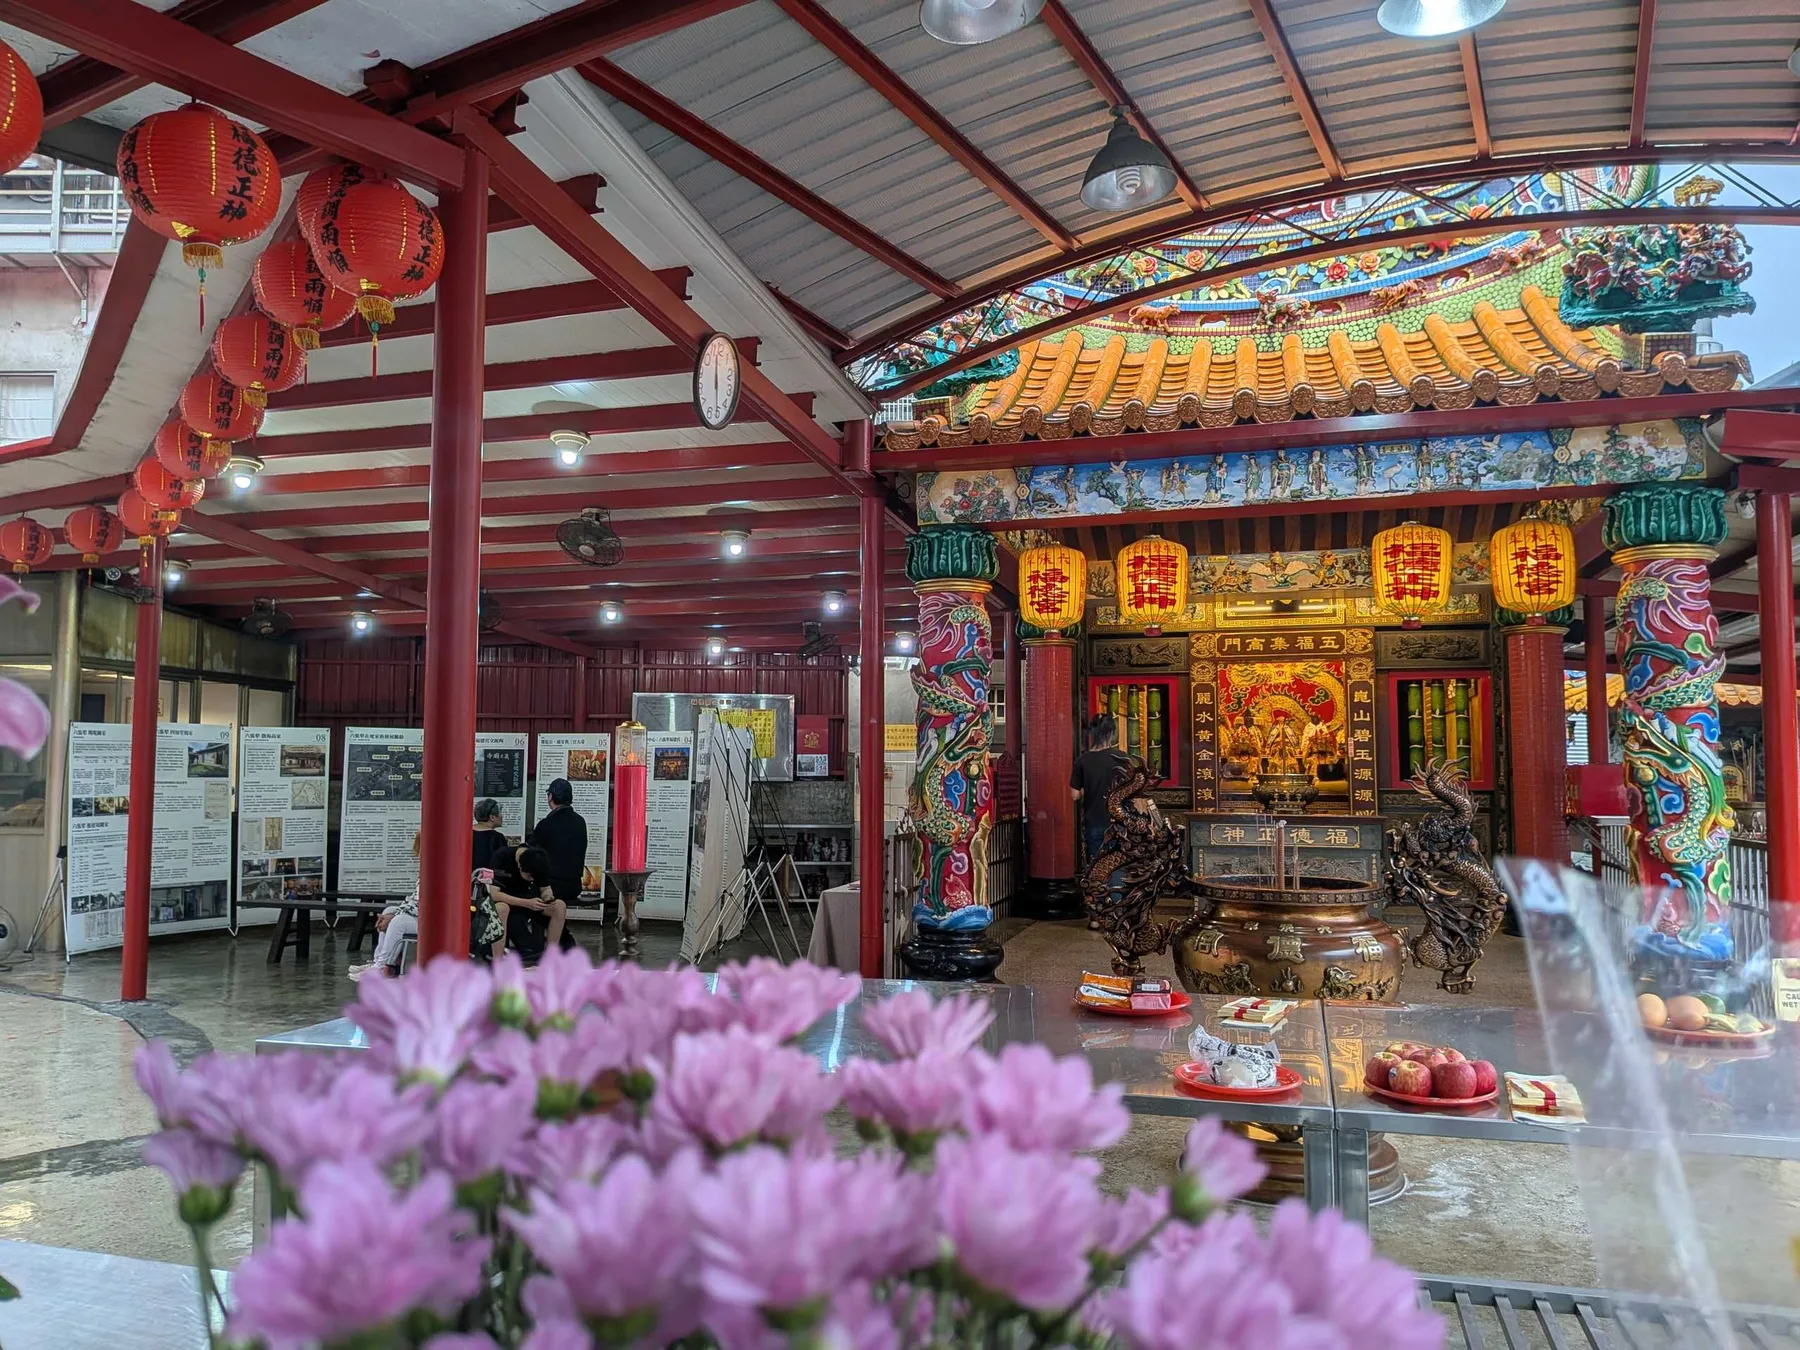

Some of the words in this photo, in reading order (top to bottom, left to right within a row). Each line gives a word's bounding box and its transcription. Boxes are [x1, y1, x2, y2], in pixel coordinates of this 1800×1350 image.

[218, 123, 261, 223] 福德正神
[1027, 568, 1070, 614] 福德宮
[1127, 555, 1178, 609] 福德正神
[1384, 543, 1440, 600] 福德正神
[1510, 544, 1564, 596] 福德宮
[1222, 636, 1340, 651] 五福集高門
[220, 731, 230, 739] 09
[514, 738, 525, 746] 06
[1195, 692, 1215, 812] 麗水黃金滾滾
[1223, 827, 1349, 845] 福德正神
